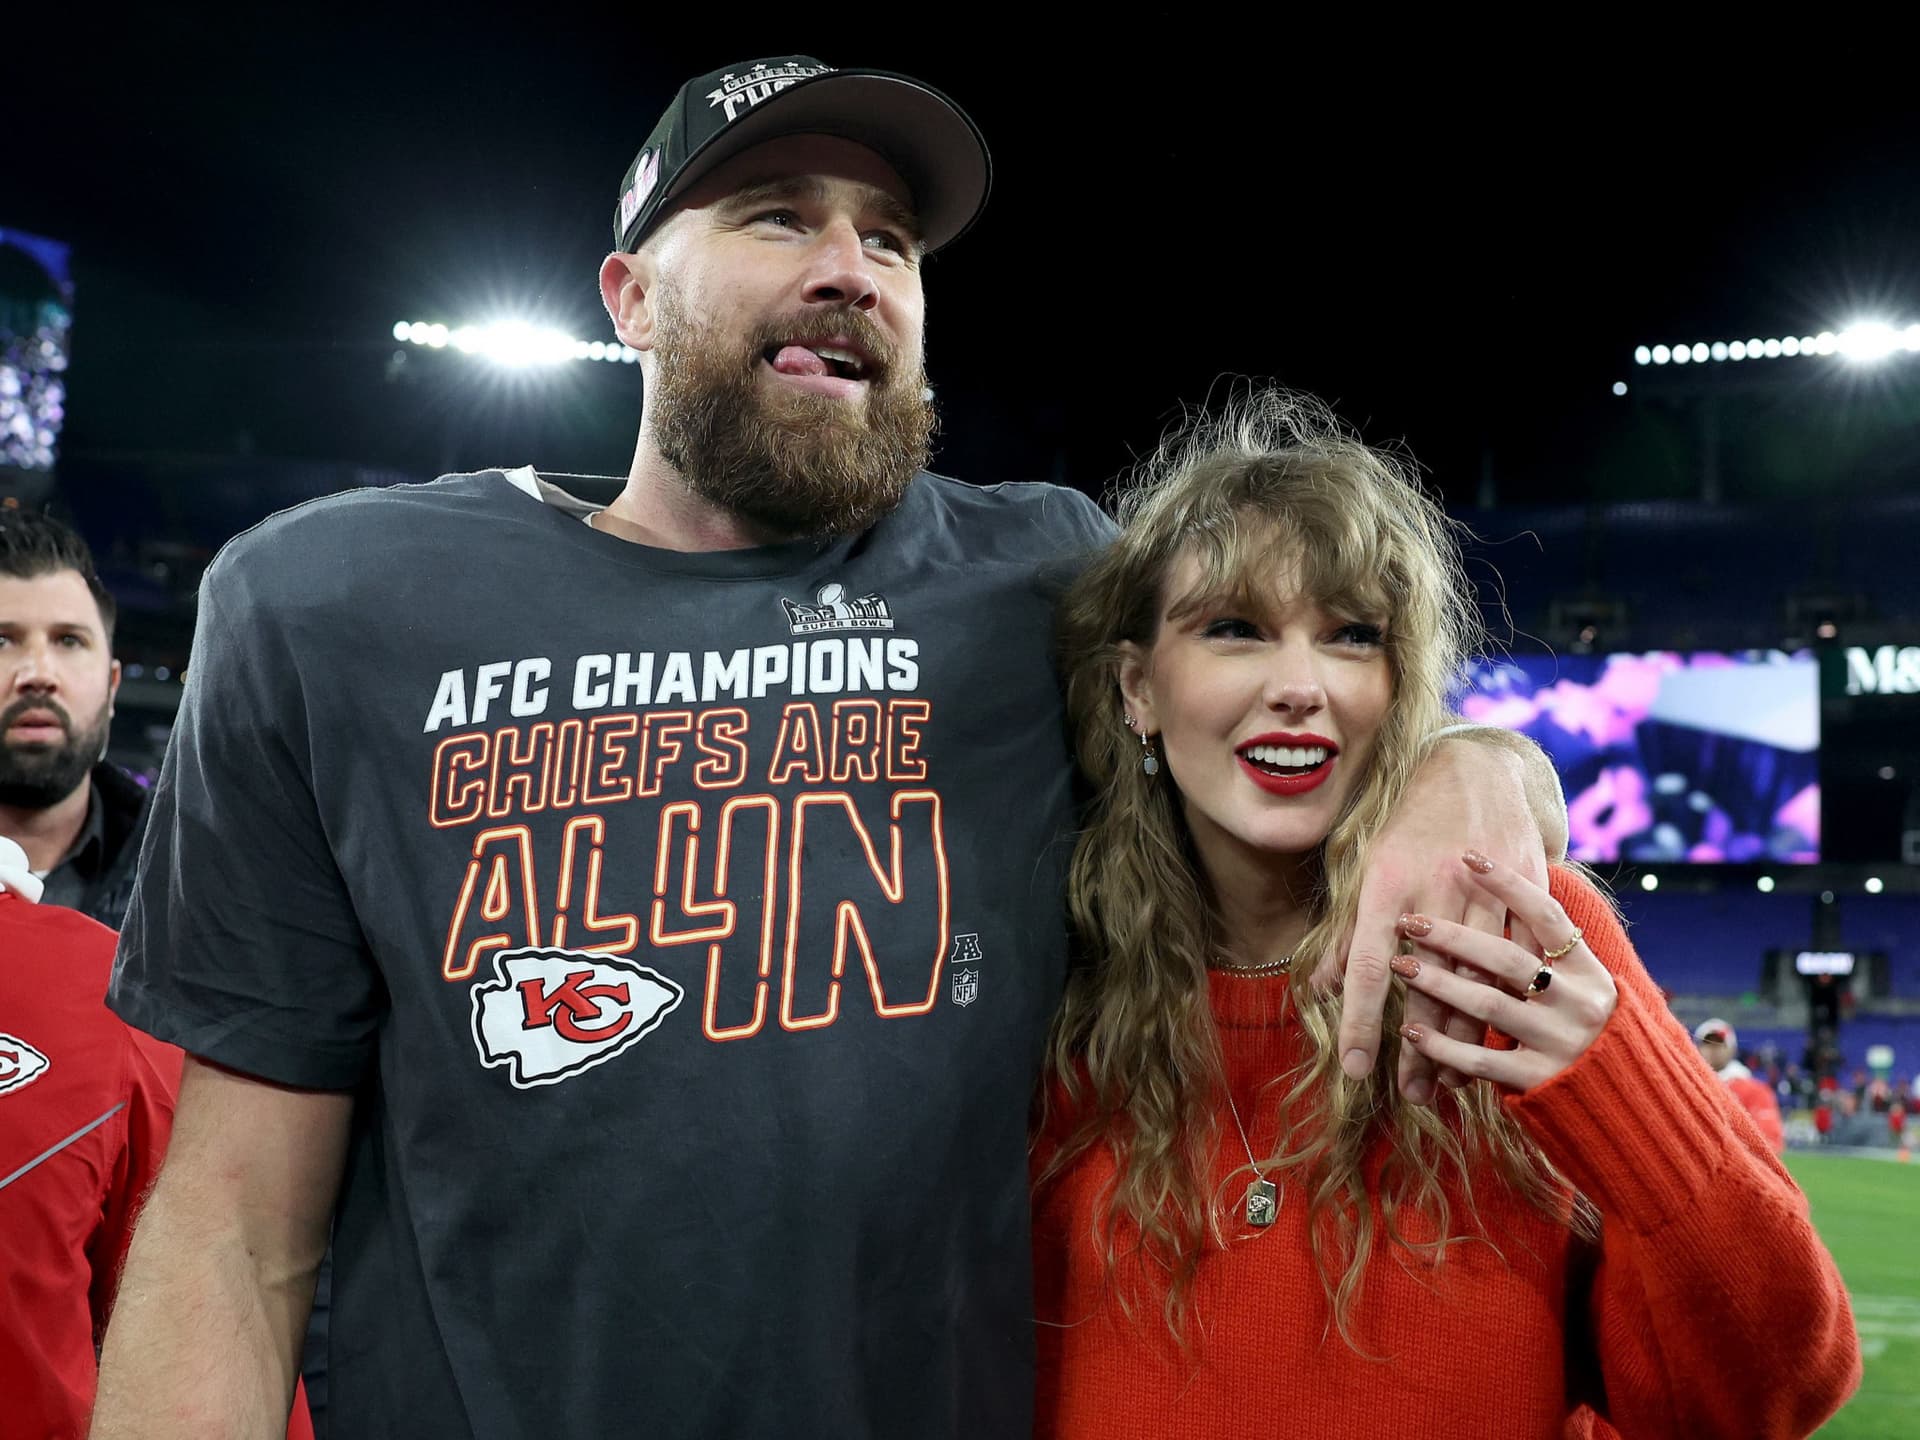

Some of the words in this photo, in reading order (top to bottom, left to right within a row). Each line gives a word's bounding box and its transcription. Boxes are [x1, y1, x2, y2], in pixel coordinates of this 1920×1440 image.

[802, 621, 844, 631] SUPER
[851, 619, 886, 627] BOWL
[423, 657, 552, 733] AFC
[572, 638, 919, 710] CHAMPIONS
[430, 707, 749, 827] CHIEFS
[768, 698, 931, 784] ARE
[443, 801, 736, 982] ALL
[703, 791, 949, 1042] IN
[516, 969, 633, 1043] KC
[954, 985, 976, 1002] NFL
